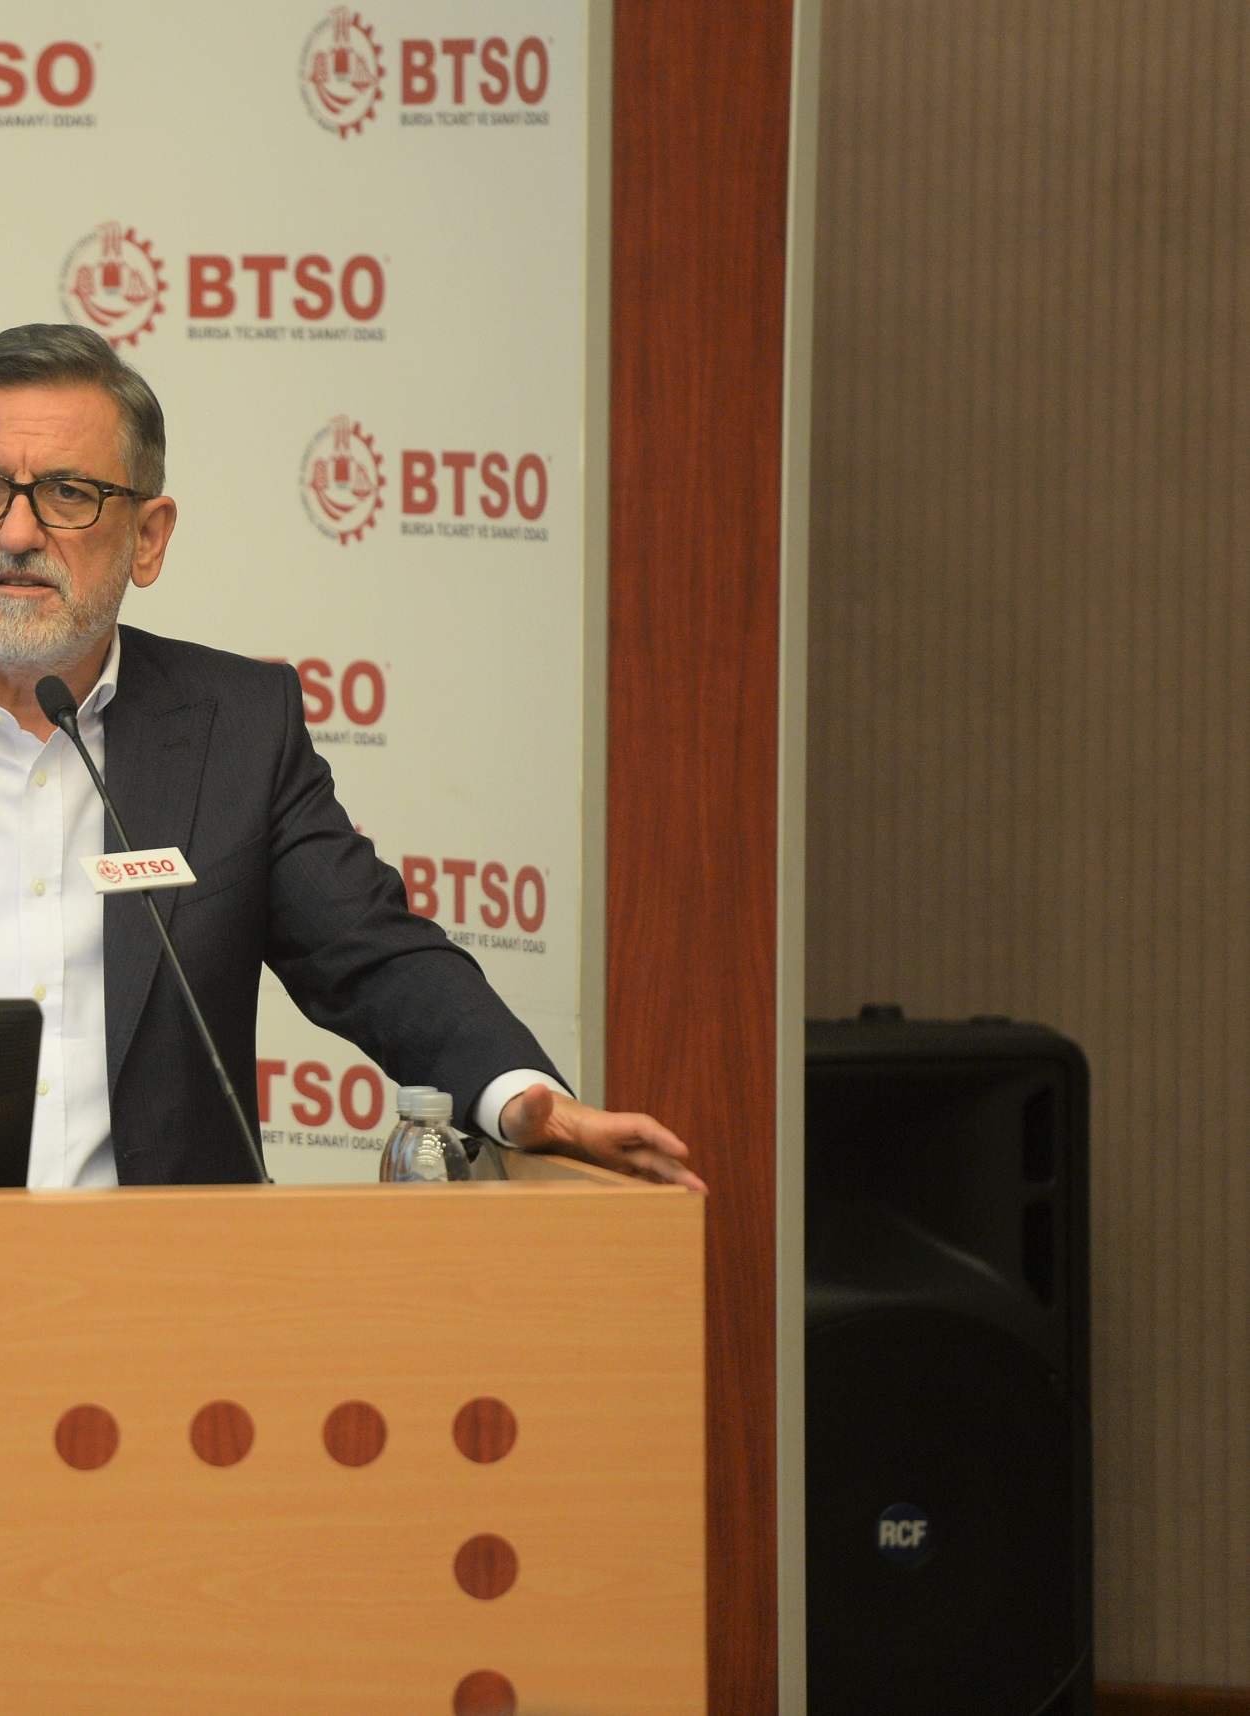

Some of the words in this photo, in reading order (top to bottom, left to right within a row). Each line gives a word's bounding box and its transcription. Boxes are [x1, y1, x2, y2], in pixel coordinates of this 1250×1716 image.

[402, 37, 548, 105] BTSO
[188, 255, 384, 321] BTSO
[402, 450, 547, 520] BTSO
[122, 859, 175, 876] BTSO
[402, 855, 546, 933] BTSO
[256, 1059, 384, 1131] TSO
[879, 1520, 928, 1548] RCF
